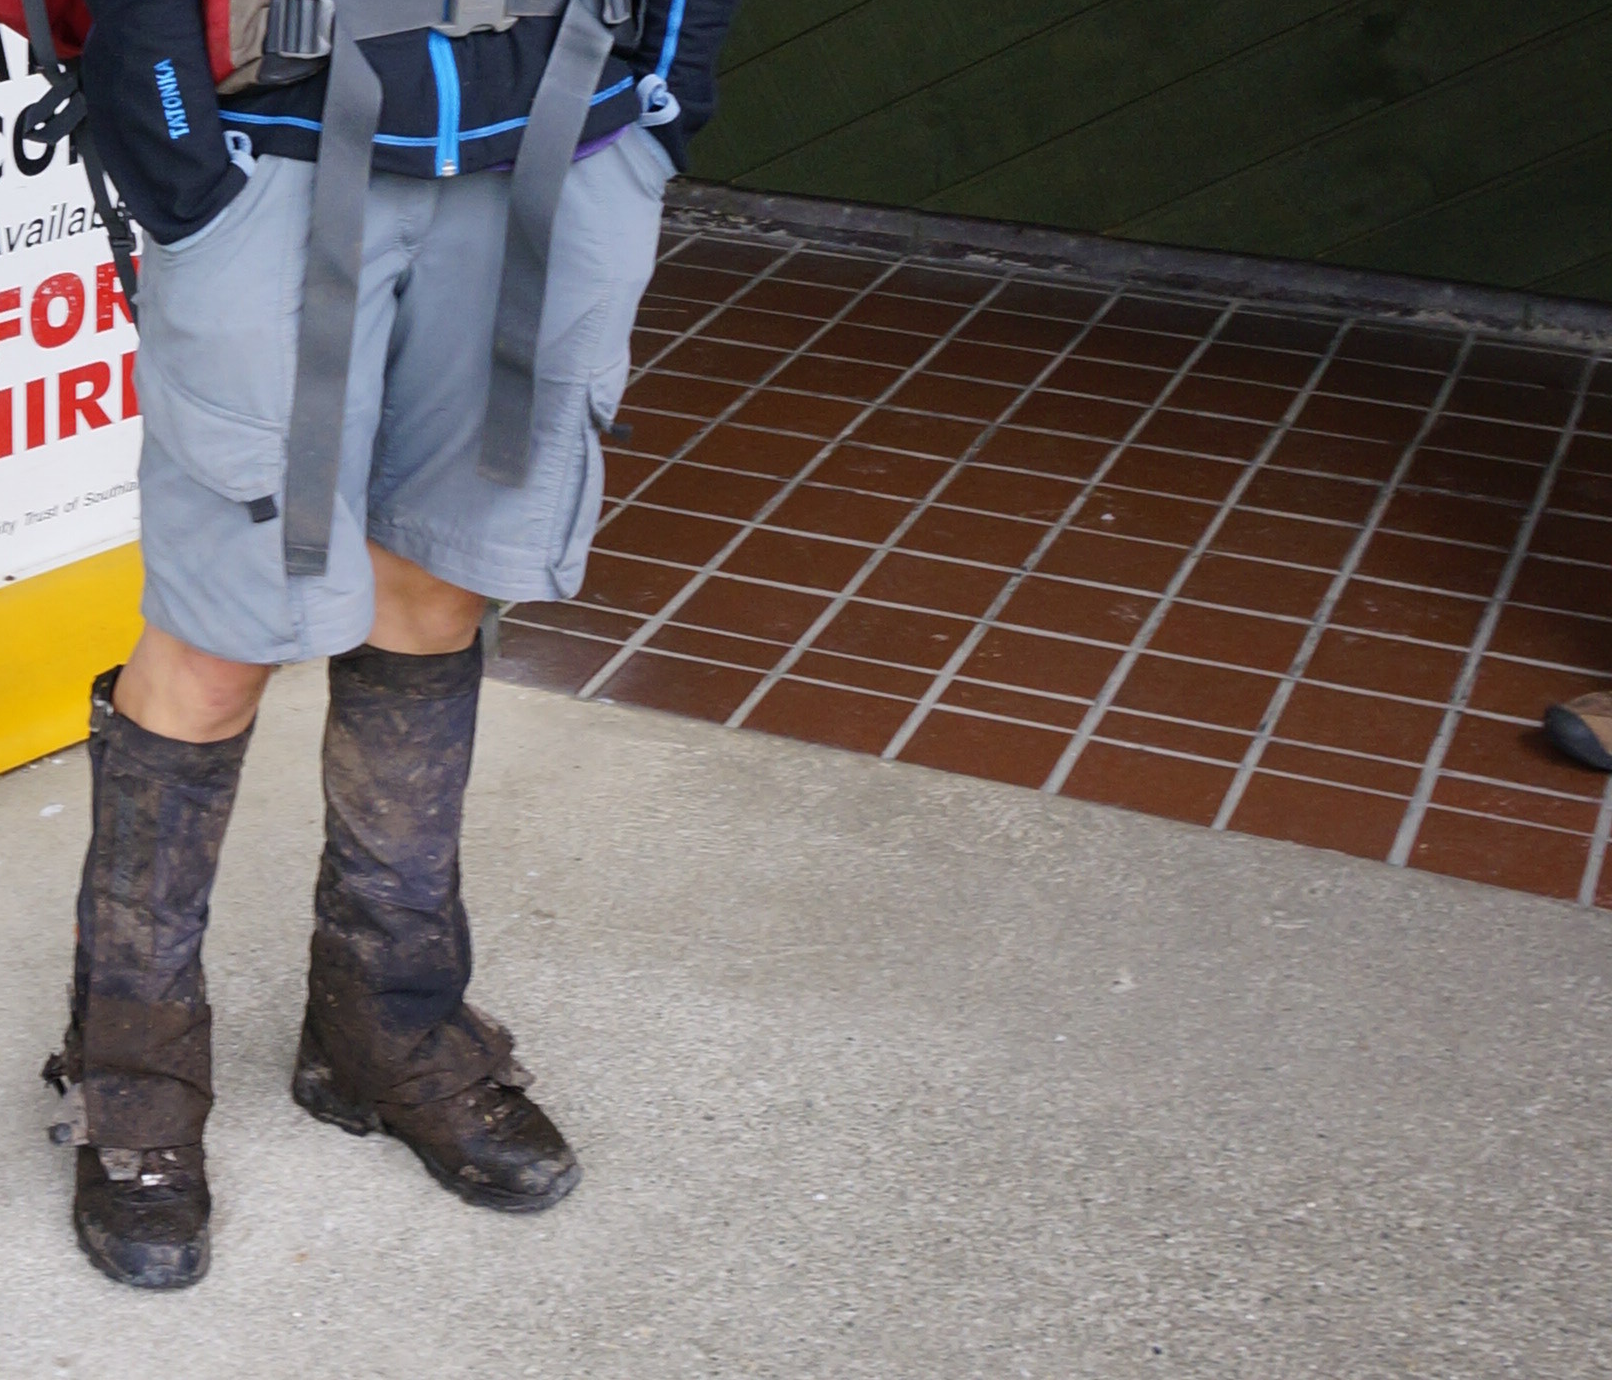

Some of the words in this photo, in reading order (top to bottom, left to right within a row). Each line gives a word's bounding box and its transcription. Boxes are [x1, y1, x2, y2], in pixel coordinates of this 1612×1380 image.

[153, 58, 190, 139] TATONKA
[23, 506, 60, 526] Trust
[63, 497, 80, 514] of
[83, 480, 140, 507] Southla
